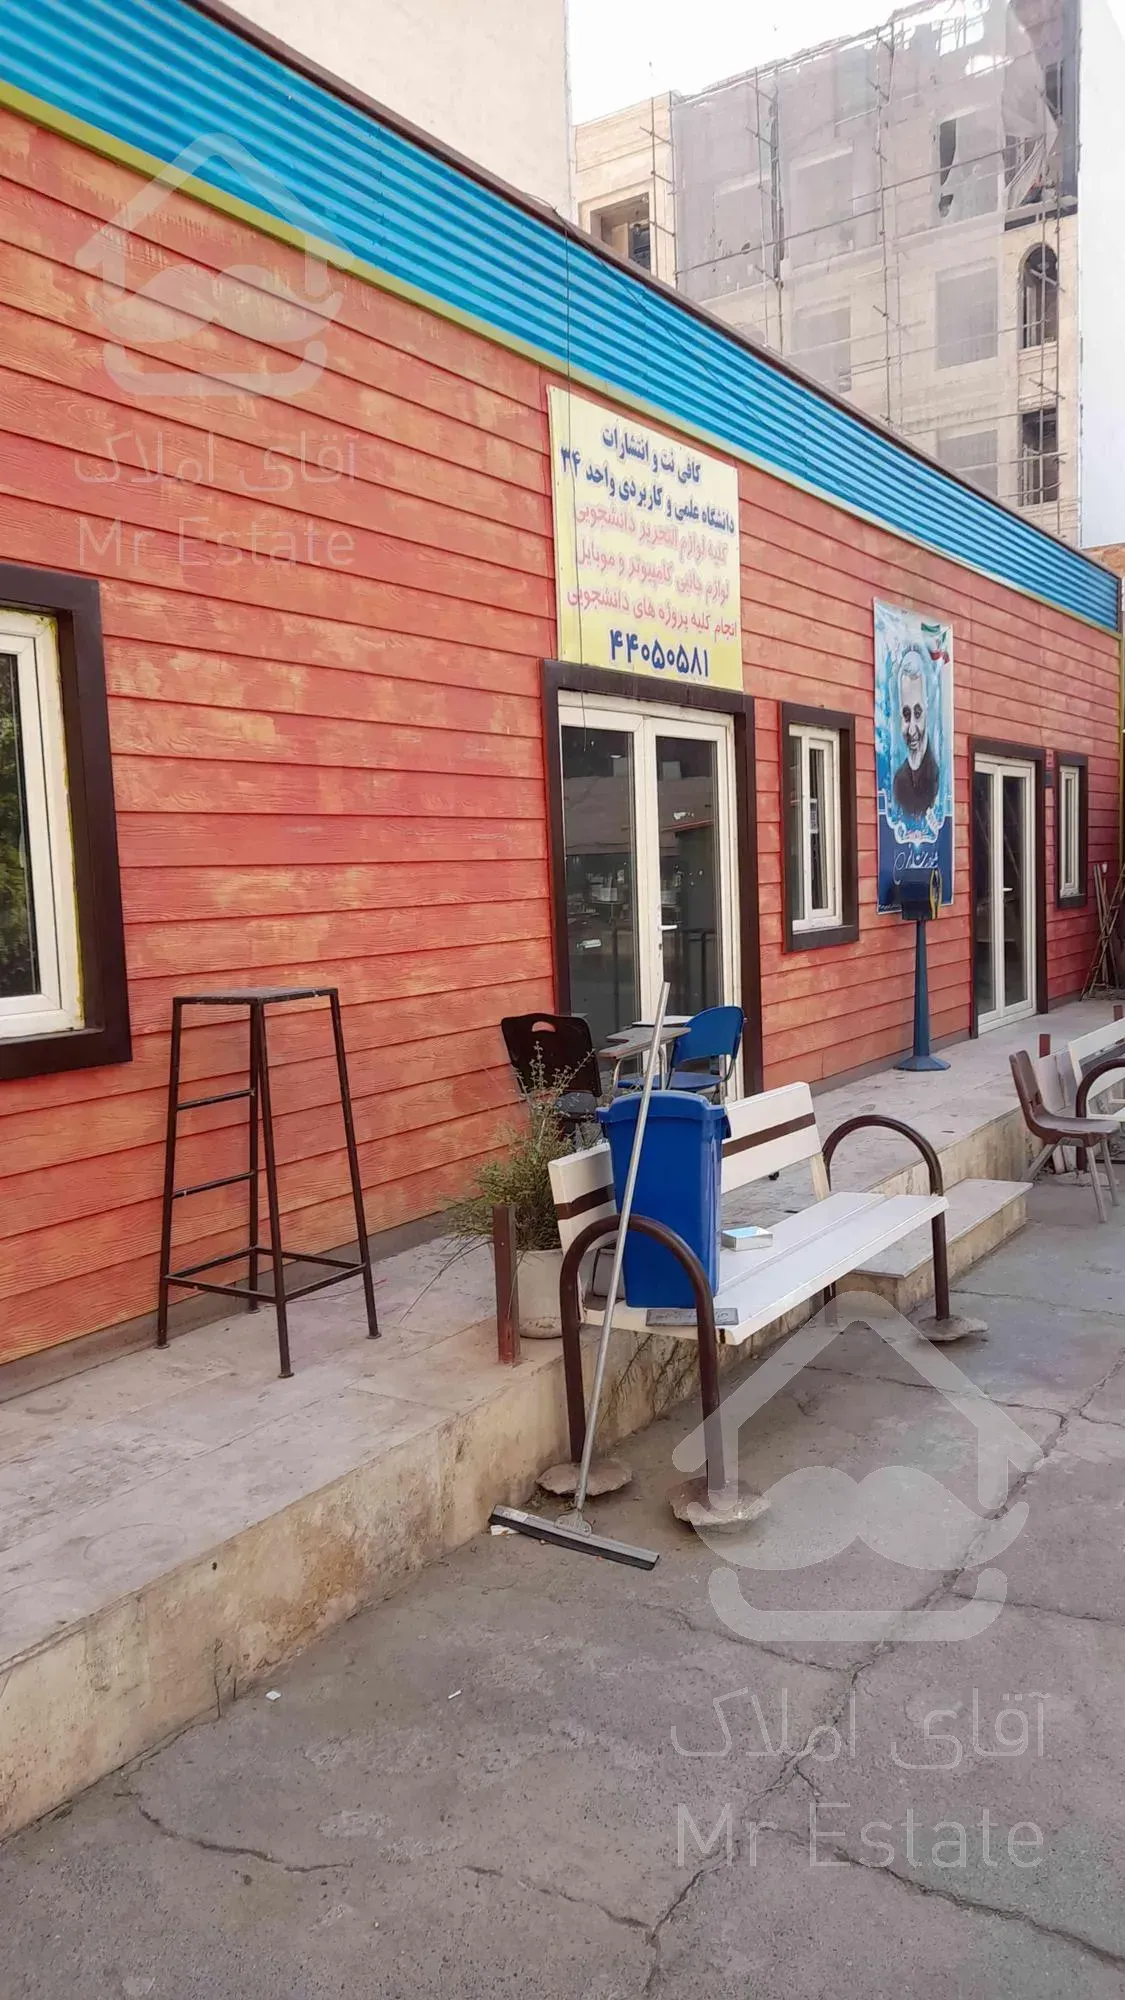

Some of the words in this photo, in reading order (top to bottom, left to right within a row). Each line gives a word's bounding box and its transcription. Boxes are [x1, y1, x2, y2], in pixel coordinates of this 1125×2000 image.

[602, 428, 649, 460] انتشارات
[652, 451, 659, 473] و
[660, 451, 675, 472] نت
[677, 458, 701, 484] کافی
[586, 466, 616, 496] واحد
[619, 480, 662, 510] کاربردی
[666, 501, 672, 518] و
[674, 498, 700, 522] علمی
[701, 504, 735, 535] دانشگاه
[566, 584, 630, 613] دانشجویی
[633, 596, 656, 620] های
[658, 601, 688, 632] پروژه
[690, 612, 711, 632] کلیه
[610, 629, 708, 676] ۴۴۰۵۰۵۸۱
